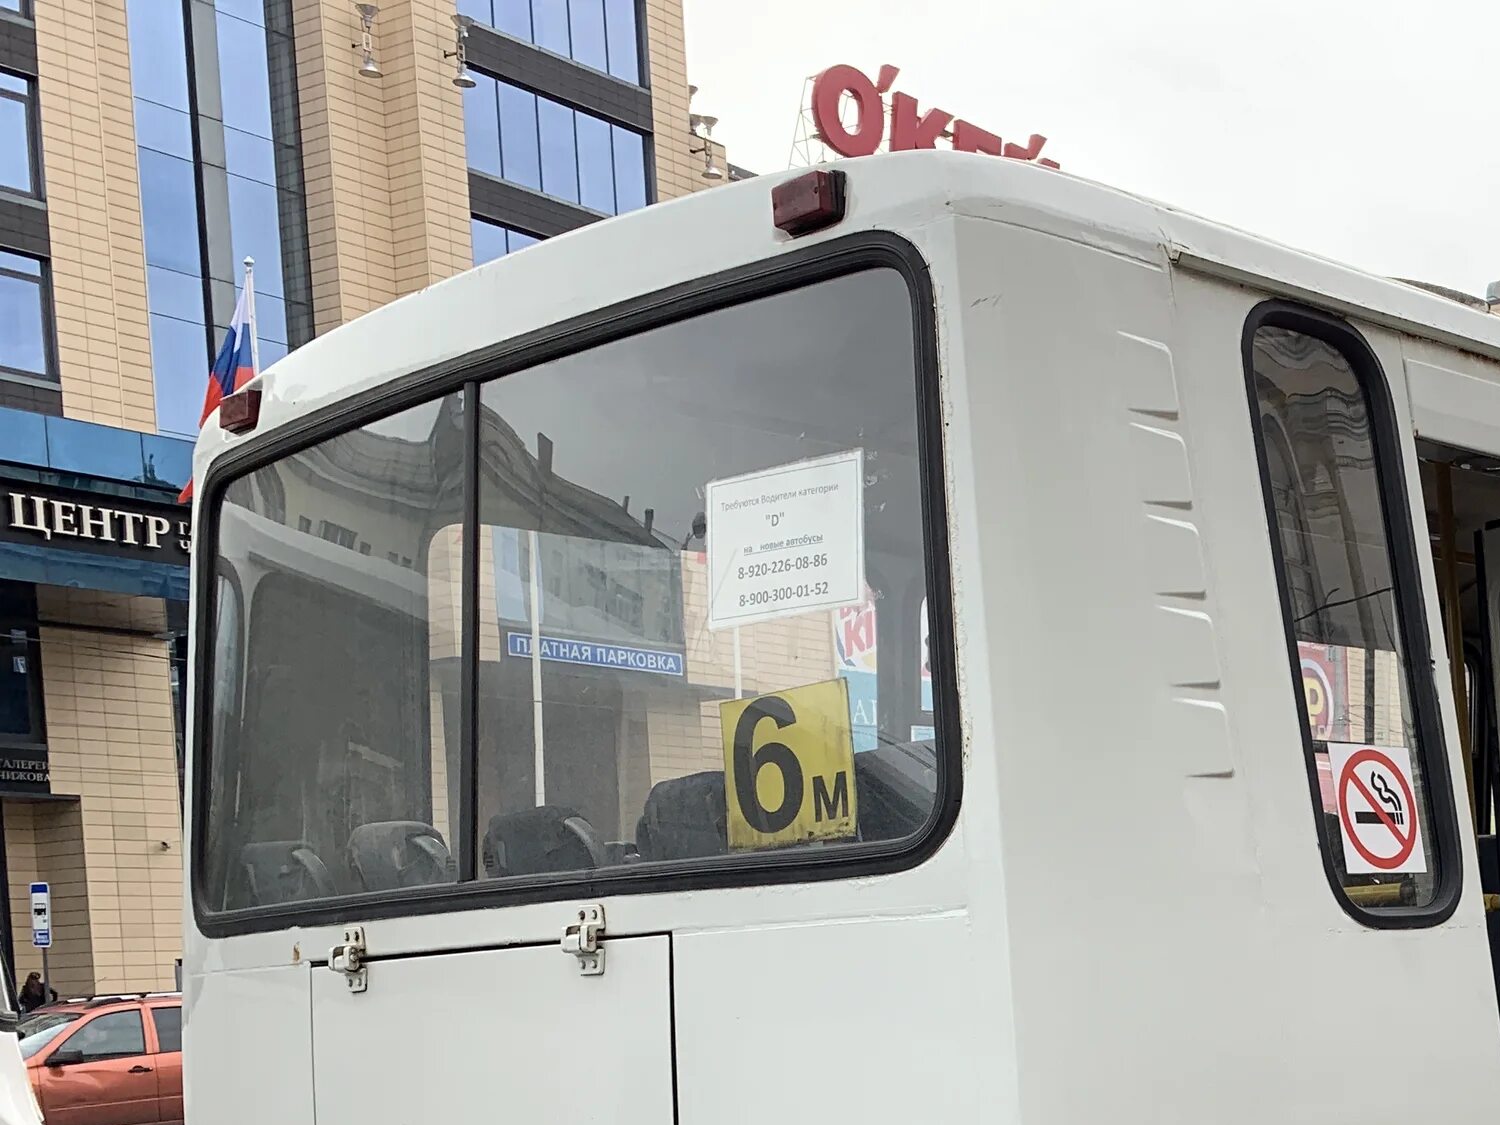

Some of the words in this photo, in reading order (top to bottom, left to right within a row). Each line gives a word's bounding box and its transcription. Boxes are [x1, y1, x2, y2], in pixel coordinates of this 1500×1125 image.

[721, 498, 760, 512] Требуются
[761, 490, 797, 505] Водители
[798, 483, 839, 497] категории
[8, 492, 170, 549] ЦЕНТР
[760, 540, 784, 551] новые
[786, 534, 824, 547] автобусы
[738, 553, 828, 579] 8-920-226-08-86
[739, 581, 829, 607] 8-900-300-01-52
[516, 637, 591, 661] ПАТНАЯ
[597, 650, 676, 671] ПАРКОВКА
